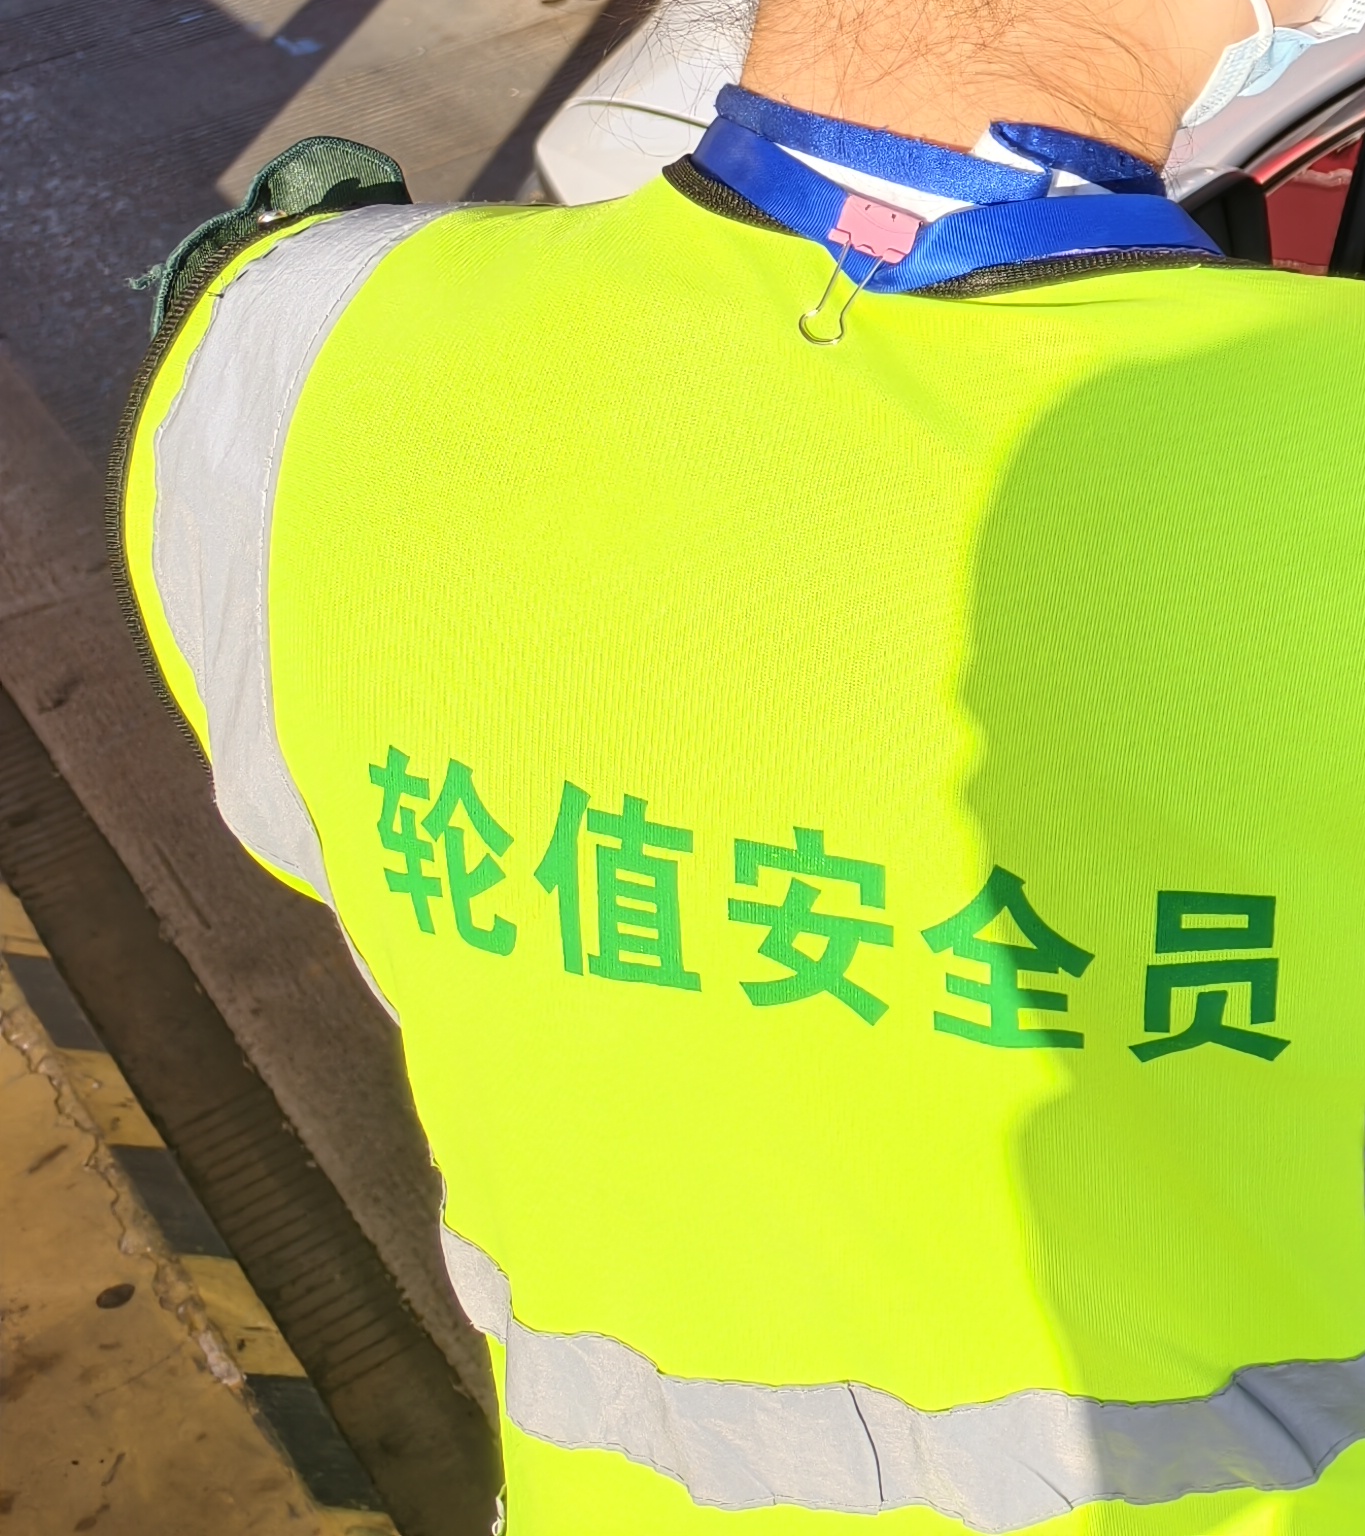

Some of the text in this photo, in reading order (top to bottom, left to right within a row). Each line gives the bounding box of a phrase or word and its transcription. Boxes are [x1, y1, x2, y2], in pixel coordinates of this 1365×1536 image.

[368, 743, 1291, 1062] 轮值安全员
